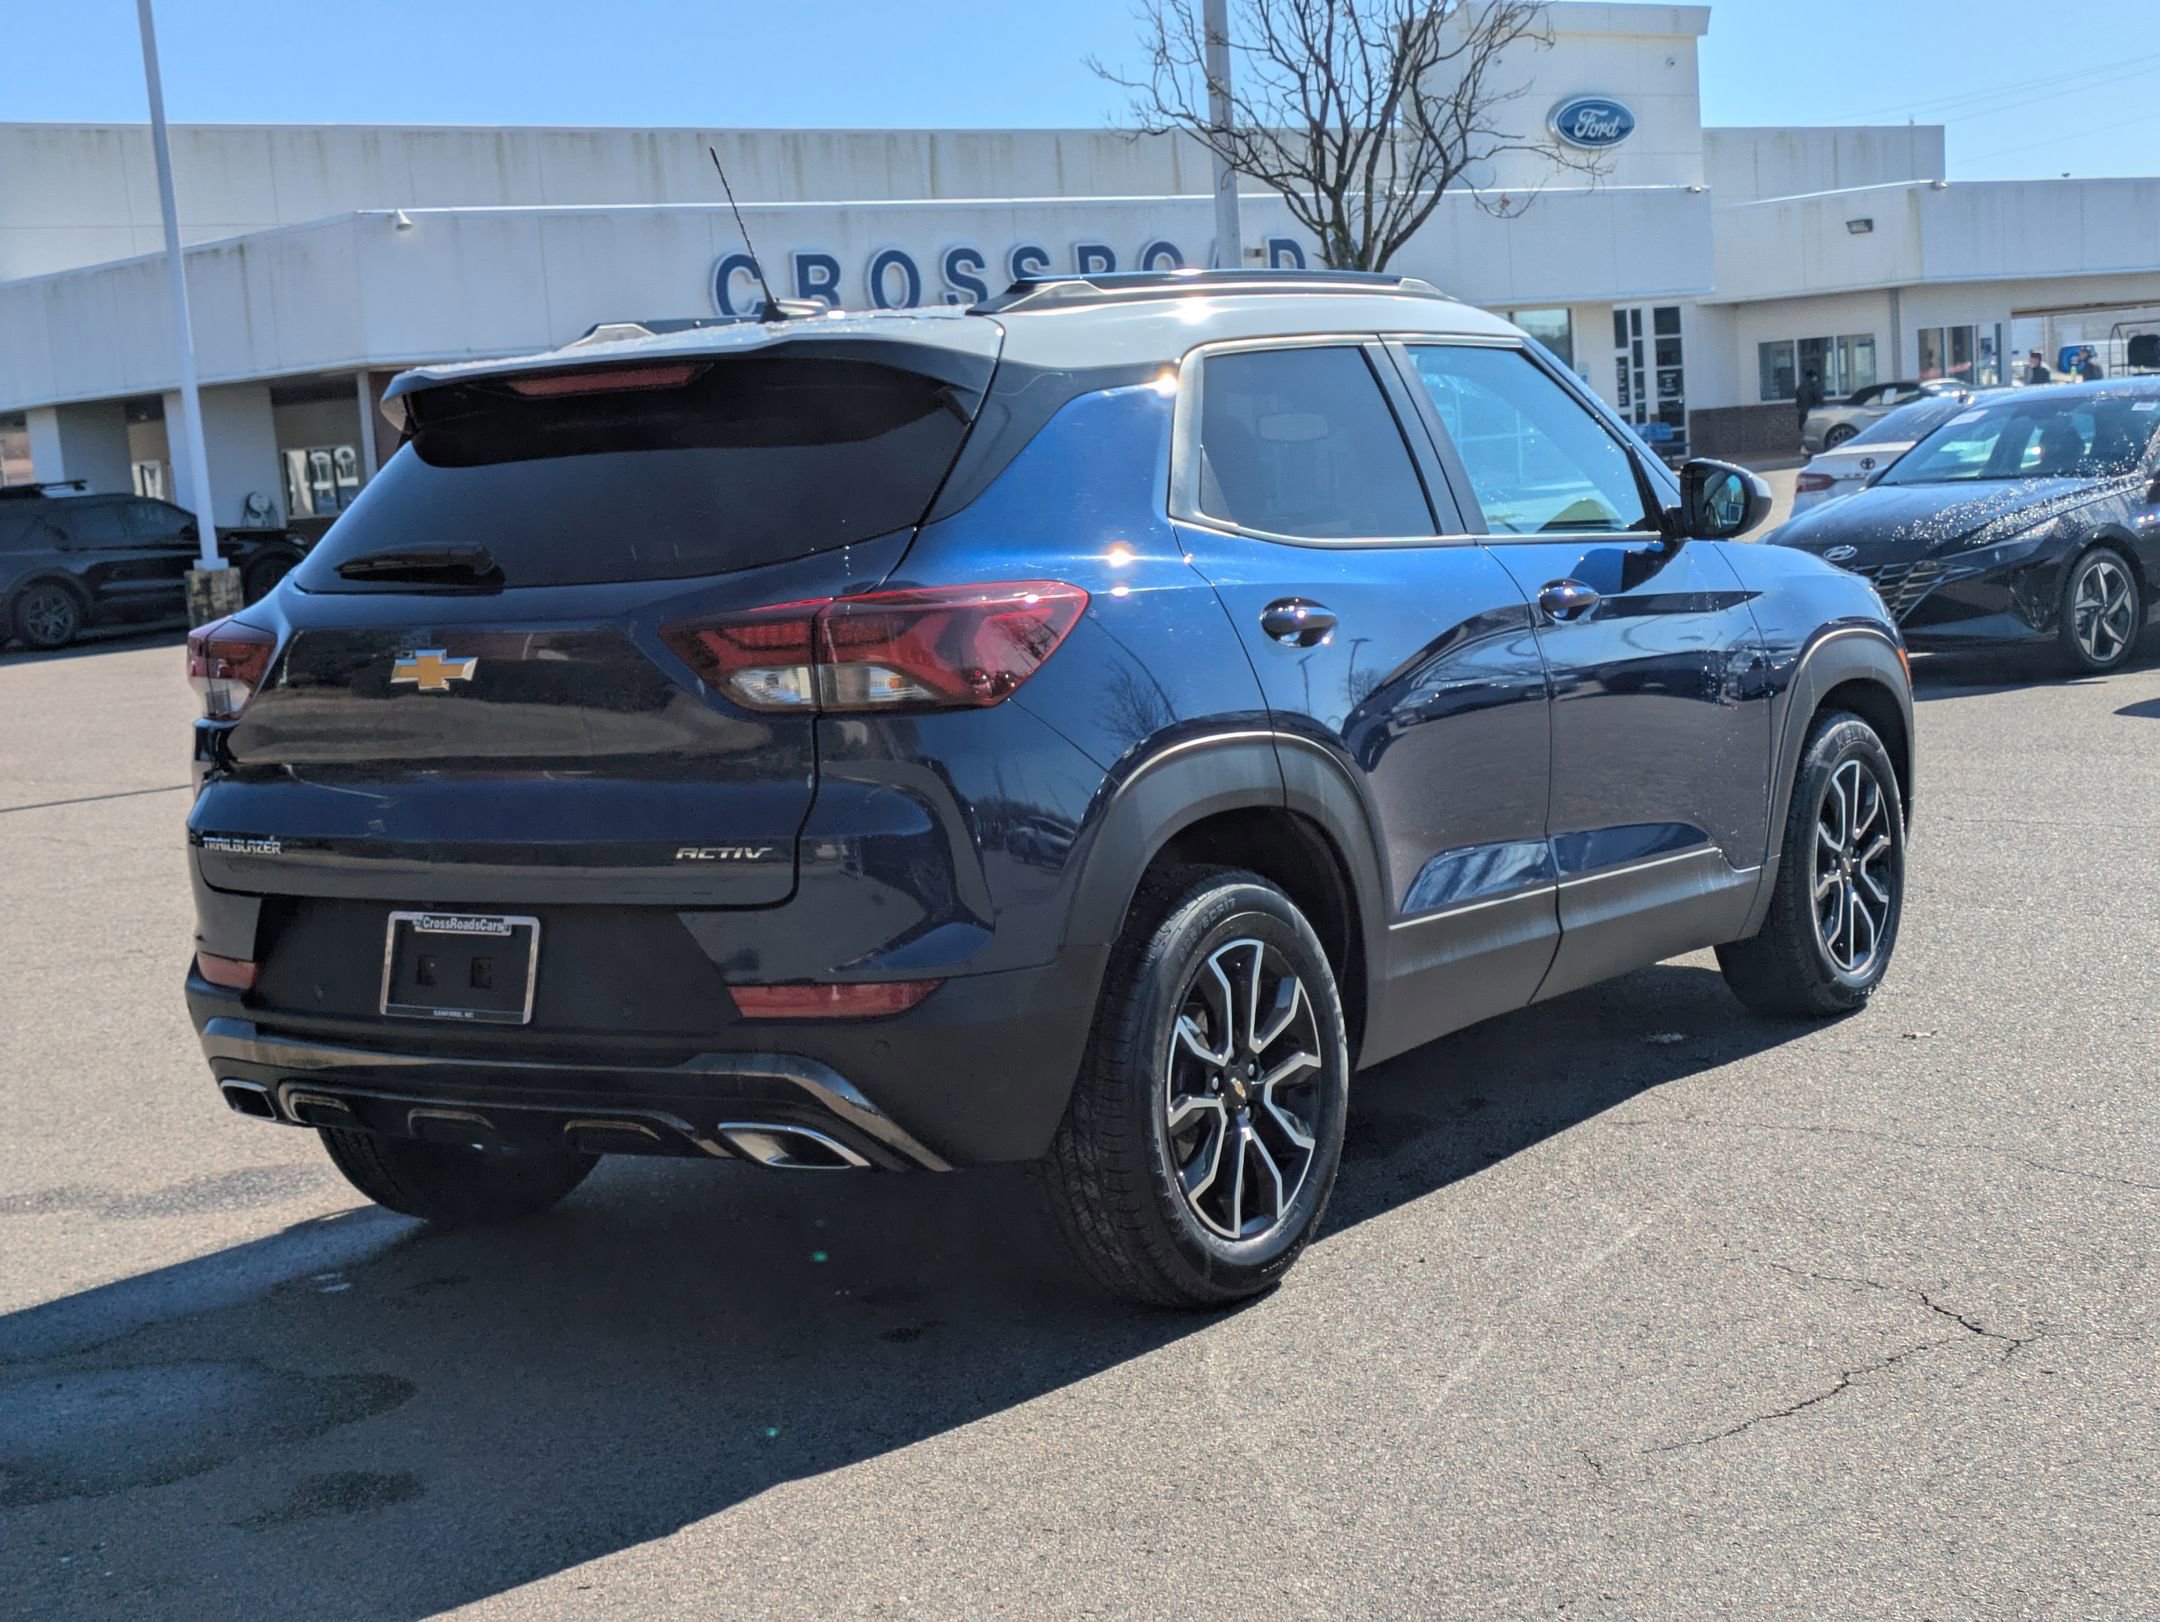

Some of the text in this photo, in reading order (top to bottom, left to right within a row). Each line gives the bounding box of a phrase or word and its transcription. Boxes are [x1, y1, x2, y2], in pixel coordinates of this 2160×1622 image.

[1574, 108, 1620, 138] Ford
[202, 836, 281, 855] TRAILBLAZER
[676, 847, 773, 859] ACTIV
